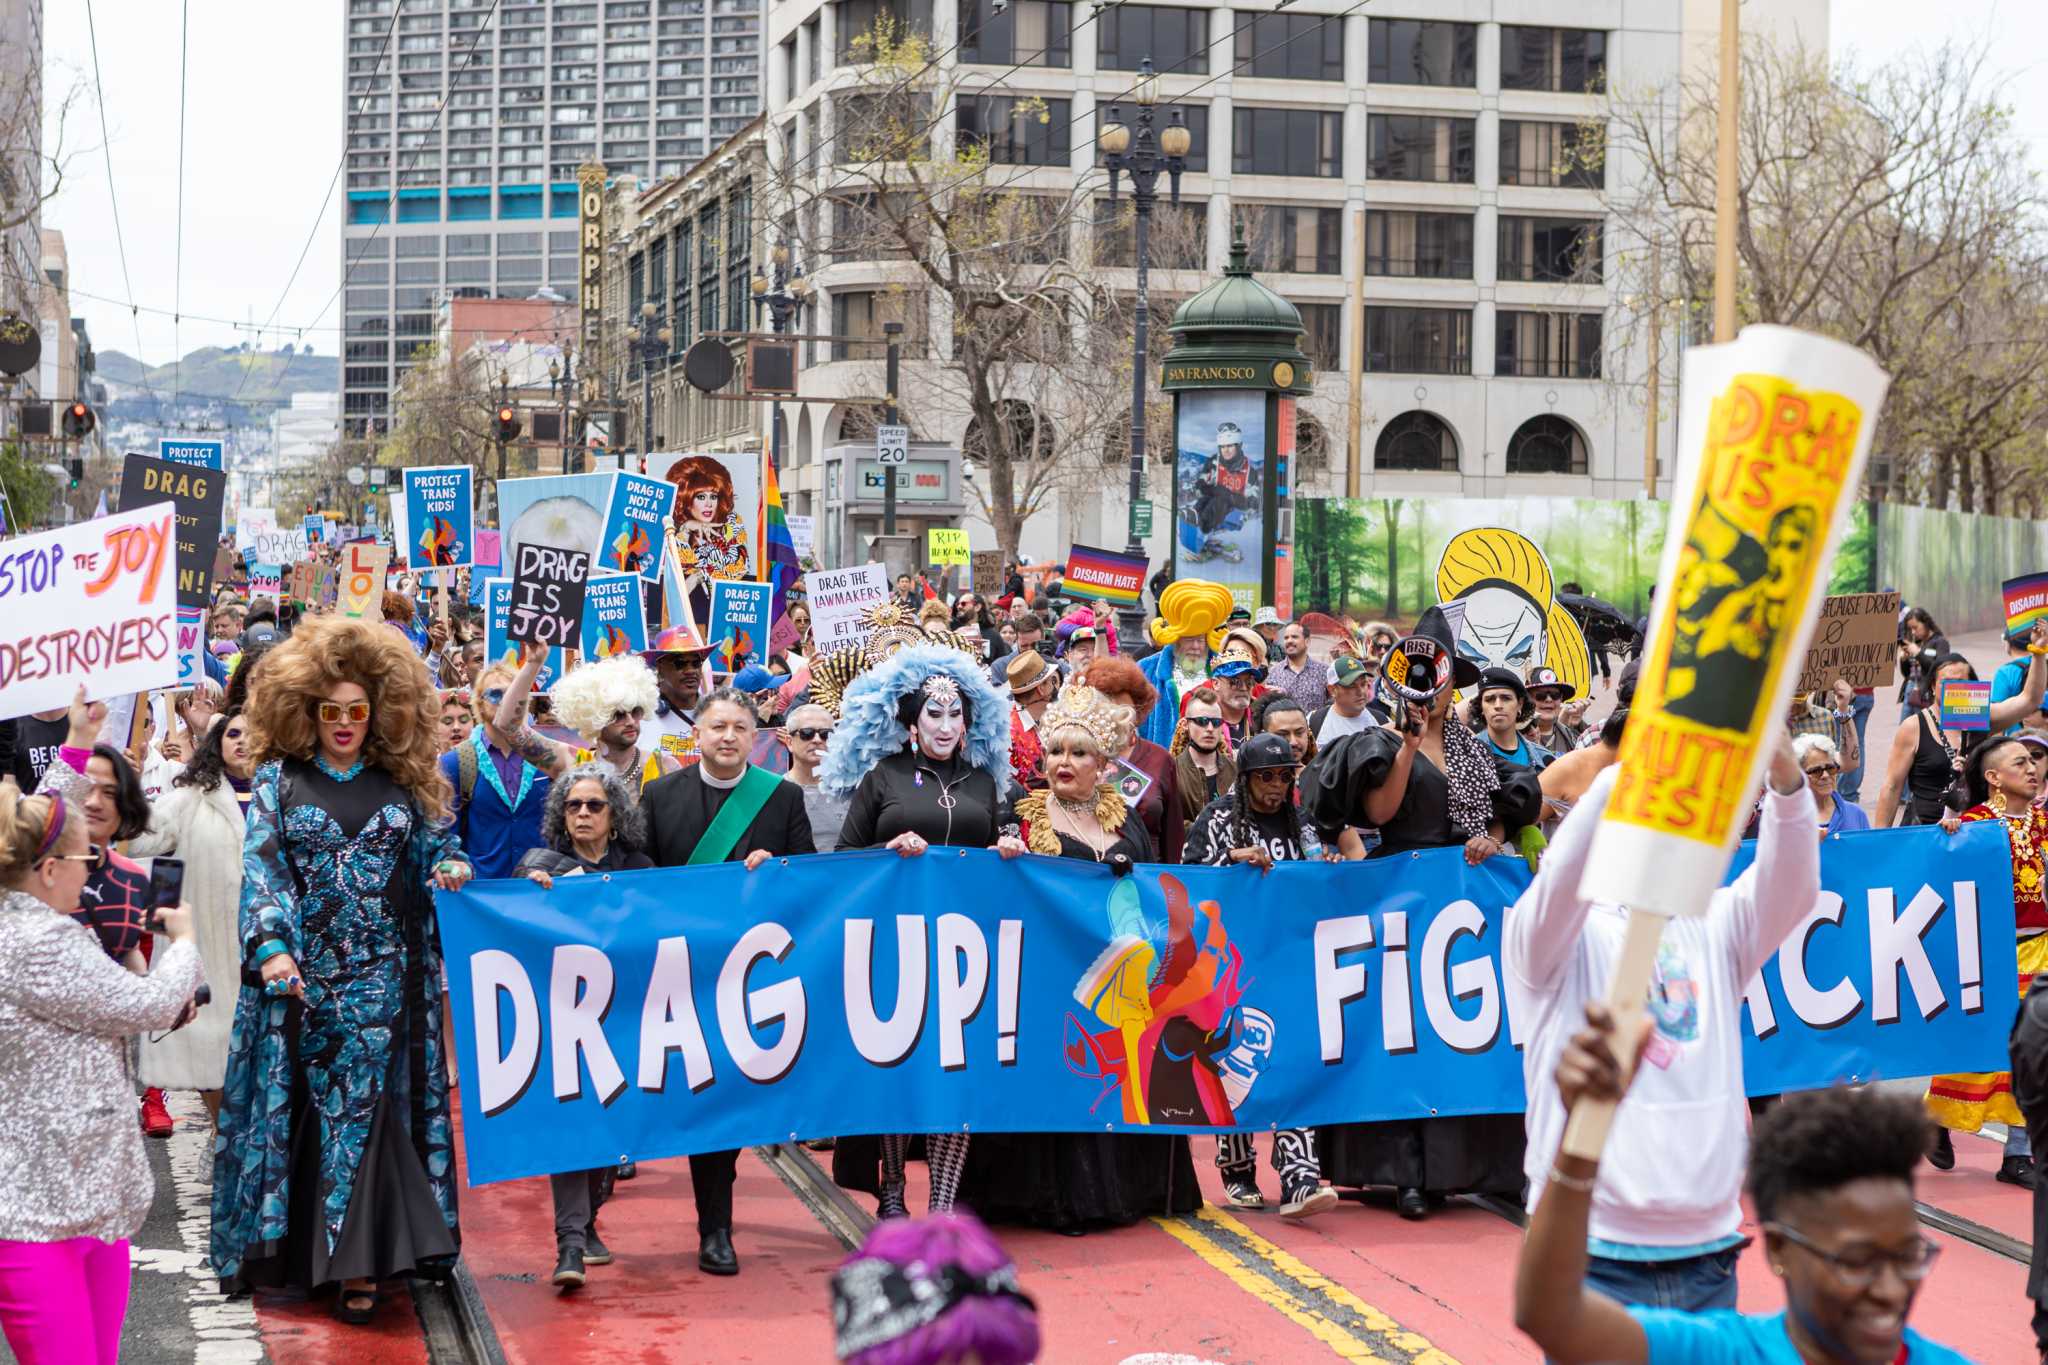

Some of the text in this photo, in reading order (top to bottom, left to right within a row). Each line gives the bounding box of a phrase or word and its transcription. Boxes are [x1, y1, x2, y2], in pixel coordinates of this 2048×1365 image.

[1169, 367, 1255, 381] SAN FRANCISCO
[168, 446, 214, 459] PROTECT
[880, 447, 905, 462] 20
[143, 467, 208, 500] DRAG
[414, 474, 462, 488] PROTECT
[626, 480, 665, 500] DRAG IS
[1720, 453, 1775, 509] IS
[421, 487, 457, 500] TRANS
[628, 494, 658, 511] NOT A
[427, 501, 455, 513] KIDS!
[623, 506, 659, 524] CRIME!
[257, 532, 307, 554] DRAG
[935, 532, 961, 545] RIP
[0, 542, 65, 598] STOP
[83, 513, 174, 606] JOY
[520, 545, 588, 584] DRAG
[252, 570, 280, 587] STOP
[348, 546, 374, 618] LOV
[818, 570, 870, 591] DRAG THE
[1072, 566, 1139, 590] DISARM HATE
[517, 580, 562, 613] IS
[584, 582, 631, 597] PROTECT
[724, 588, 760, 601] DRAG IS
[814, 586, 882, 609] LAWMAKERS
[1231, 588, 1255, 601] ORE
[591, 596, 627, 609] TRANS
[728, 601, 756, 612] NOT A
[1865, 593, 1897, 614] DRAG
[2009, 592, 2045, 615] DISARM
[598, 608, 627, 622] KIDS!
[724, 612, 758, 625] CRIME!
[512, 608, 575, 645] JOY
[833, 620, 850, 636] LET
[0, 614, 172, 688] DESTROYERS
[820, 635, 861, 656] QUEENS
[1406, 640, 1433, 656] RISE
[1820, 646, 1840, 669] GUN
[29, 746, 48, 764] BE
[32, 764, 46, 779] TO
[1259, 837, 1286, 861] AG
[469, 879, 1985, 1119] DRAG UP! FiG CK!
